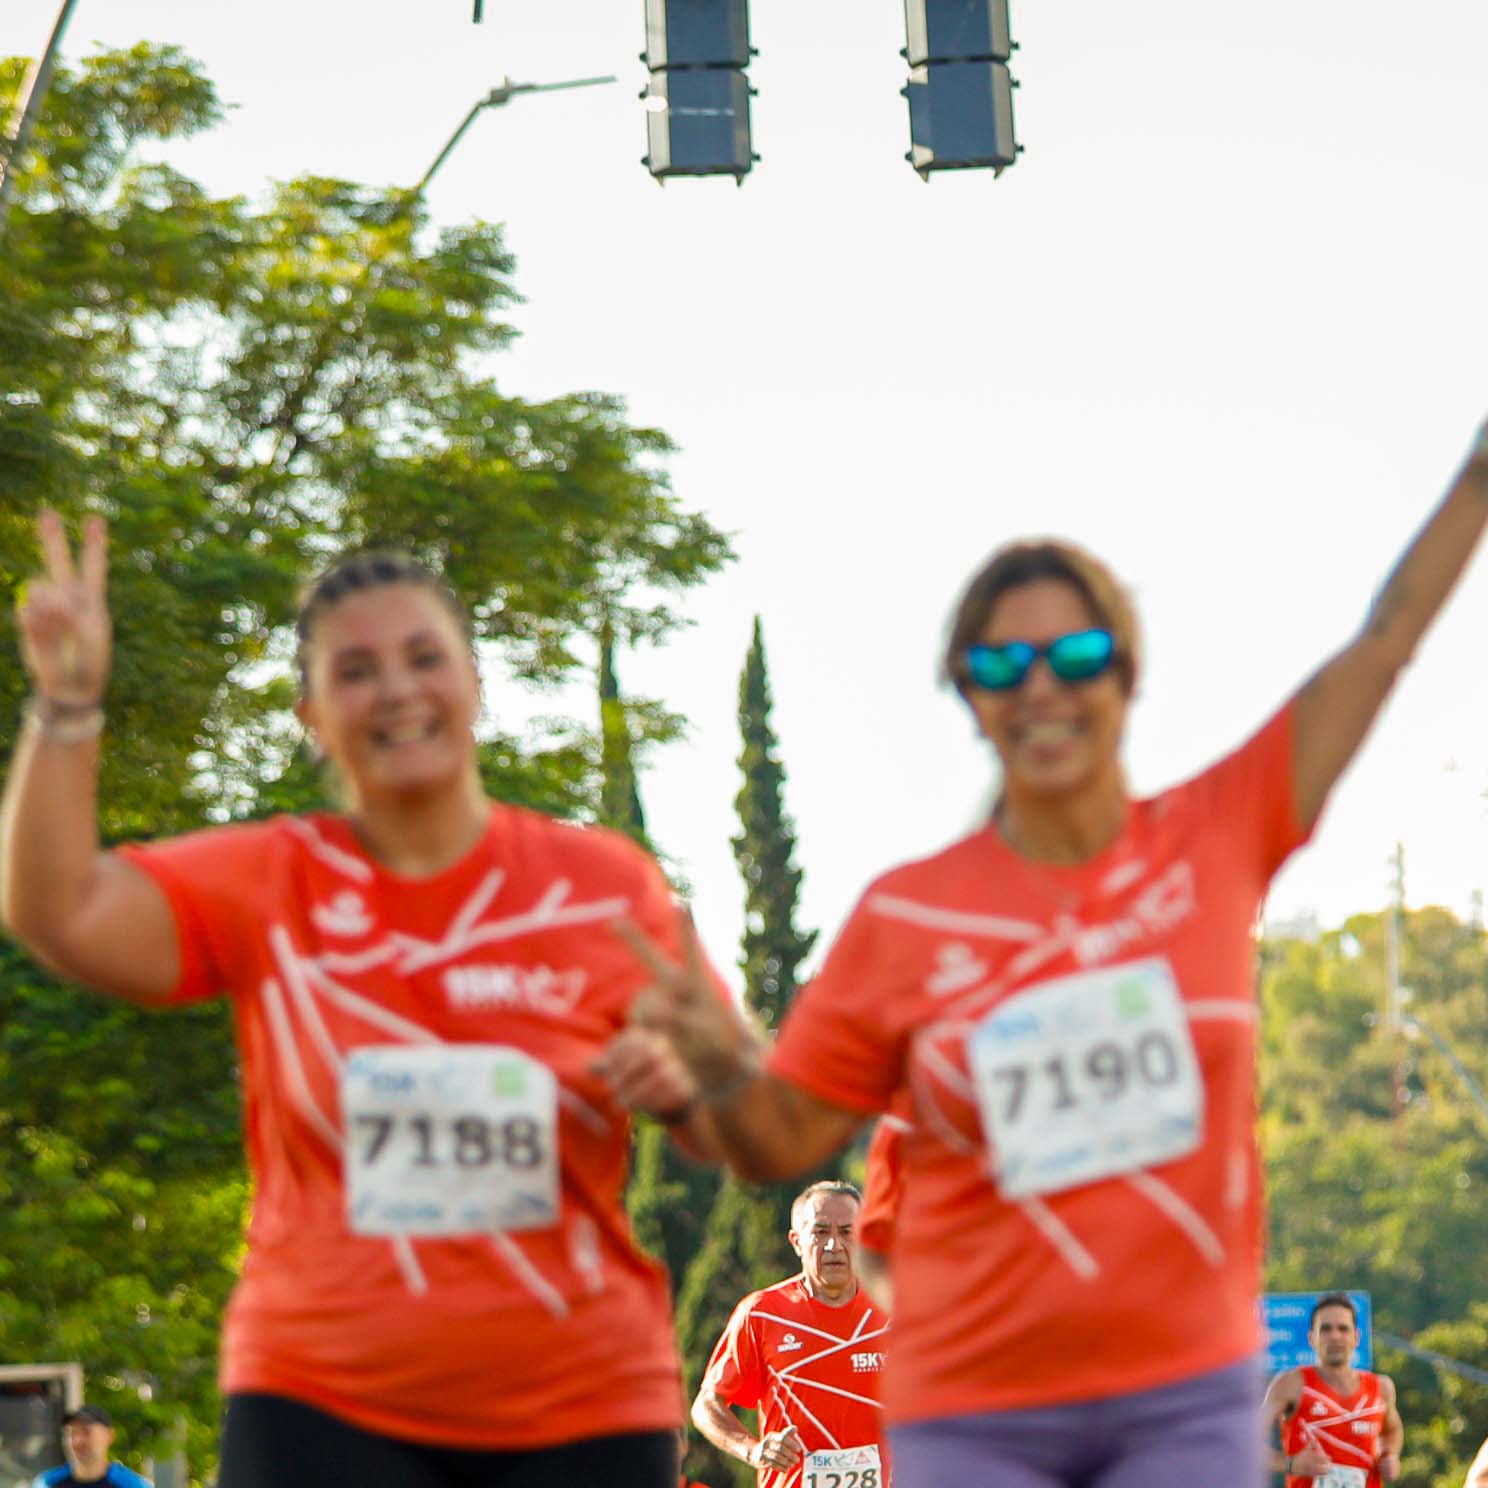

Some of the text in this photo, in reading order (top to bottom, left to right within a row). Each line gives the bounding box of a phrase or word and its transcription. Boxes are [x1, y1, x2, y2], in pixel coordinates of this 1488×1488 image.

[992, 1029, 1179, 1125] 7190
[356, 1114, 542, 1169] 7188
[850, 1352, 878, 1369] 15K
[812, 1455, 832, 1467] 15K
